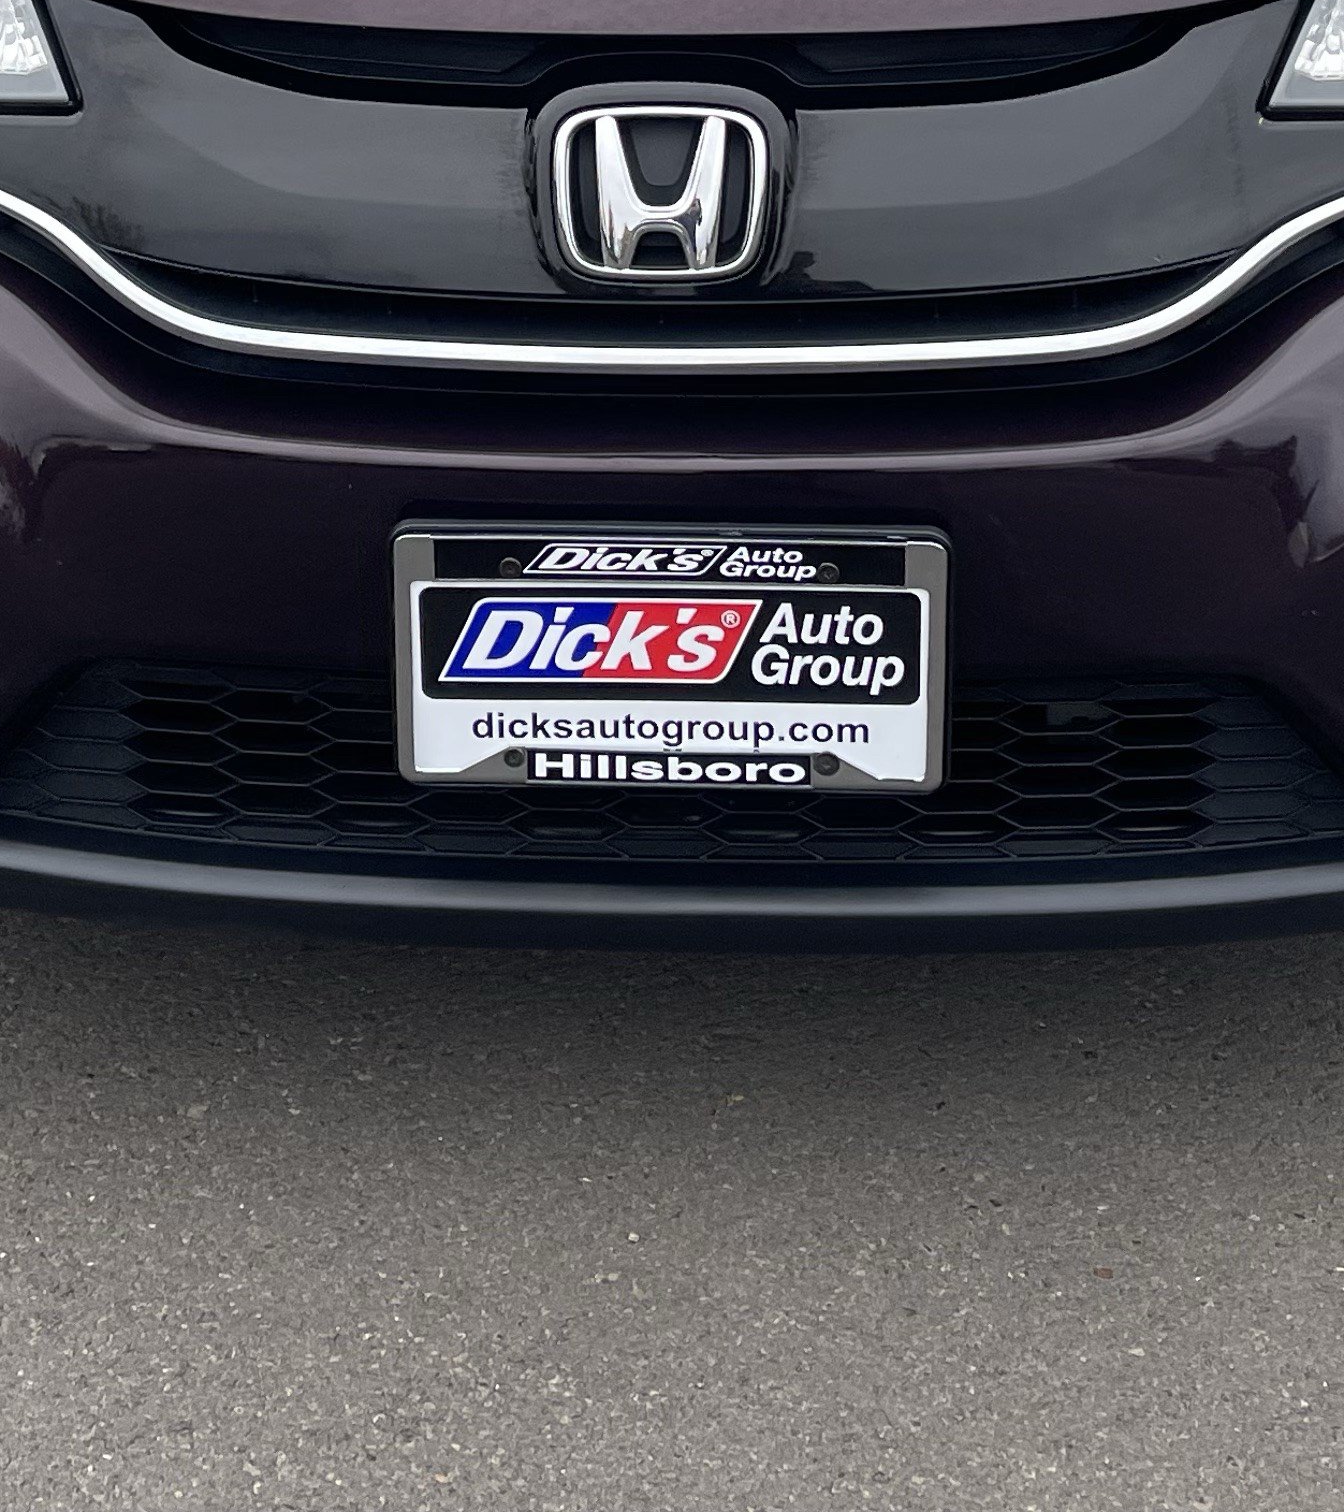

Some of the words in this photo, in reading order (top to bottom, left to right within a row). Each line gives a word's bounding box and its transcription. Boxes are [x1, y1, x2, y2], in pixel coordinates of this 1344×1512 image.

[719, 561, 816, 581] Group
[727, 546, 803, 563] Auto
[759, 602, 884, 645] Auto
[751, 643, 905, 696] Group
[472, 712, 869, 749] dicksautogroup.com
[535, 753, 806, 783] Hillsboro
